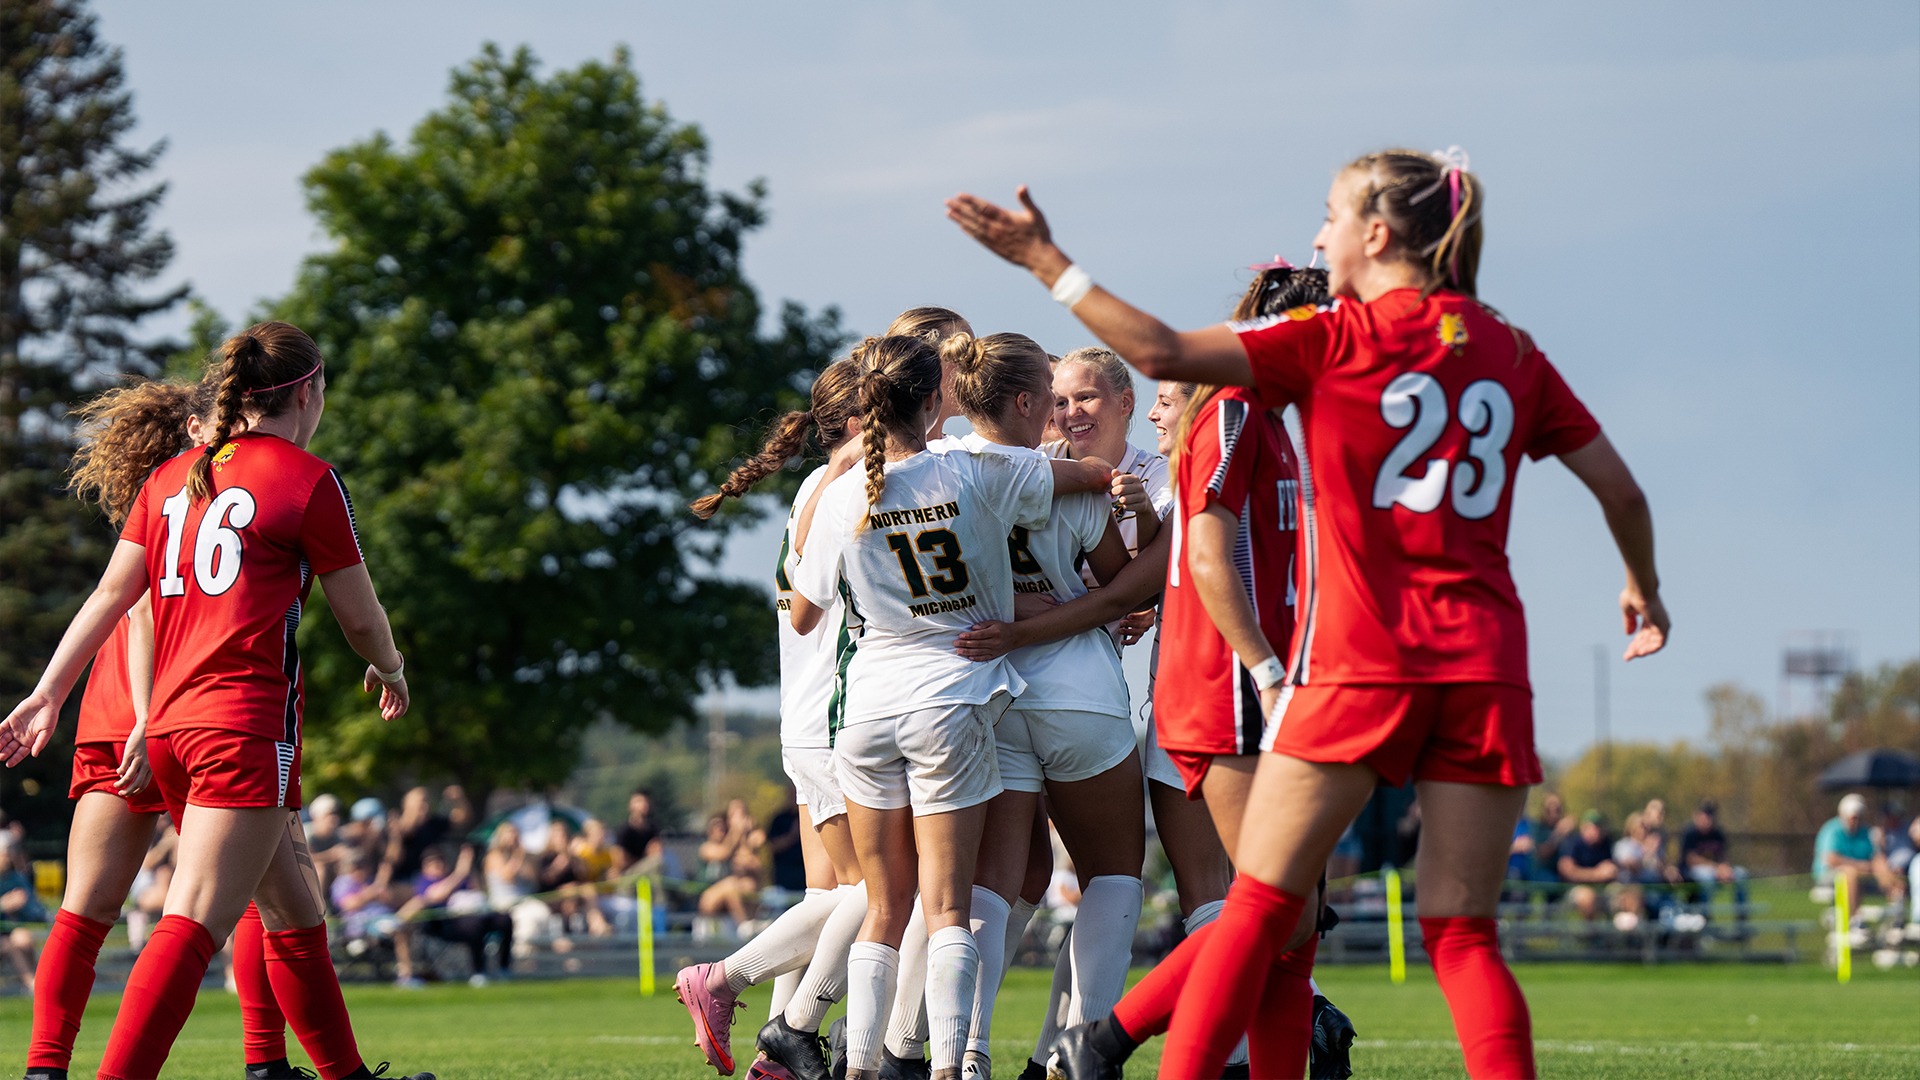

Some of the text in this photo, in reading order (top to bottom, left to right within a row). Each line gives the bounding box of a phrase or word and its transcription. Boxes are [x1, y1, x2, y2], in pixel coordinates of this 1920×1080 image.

[1372, 371, 1515, 520] 23
[160, 483, 257, 597] 16
[870, 501, 961, 530] NORTHERN
[885, 527, 970, 599] 13
[908, 595, 977, 619] MICHIGAN
